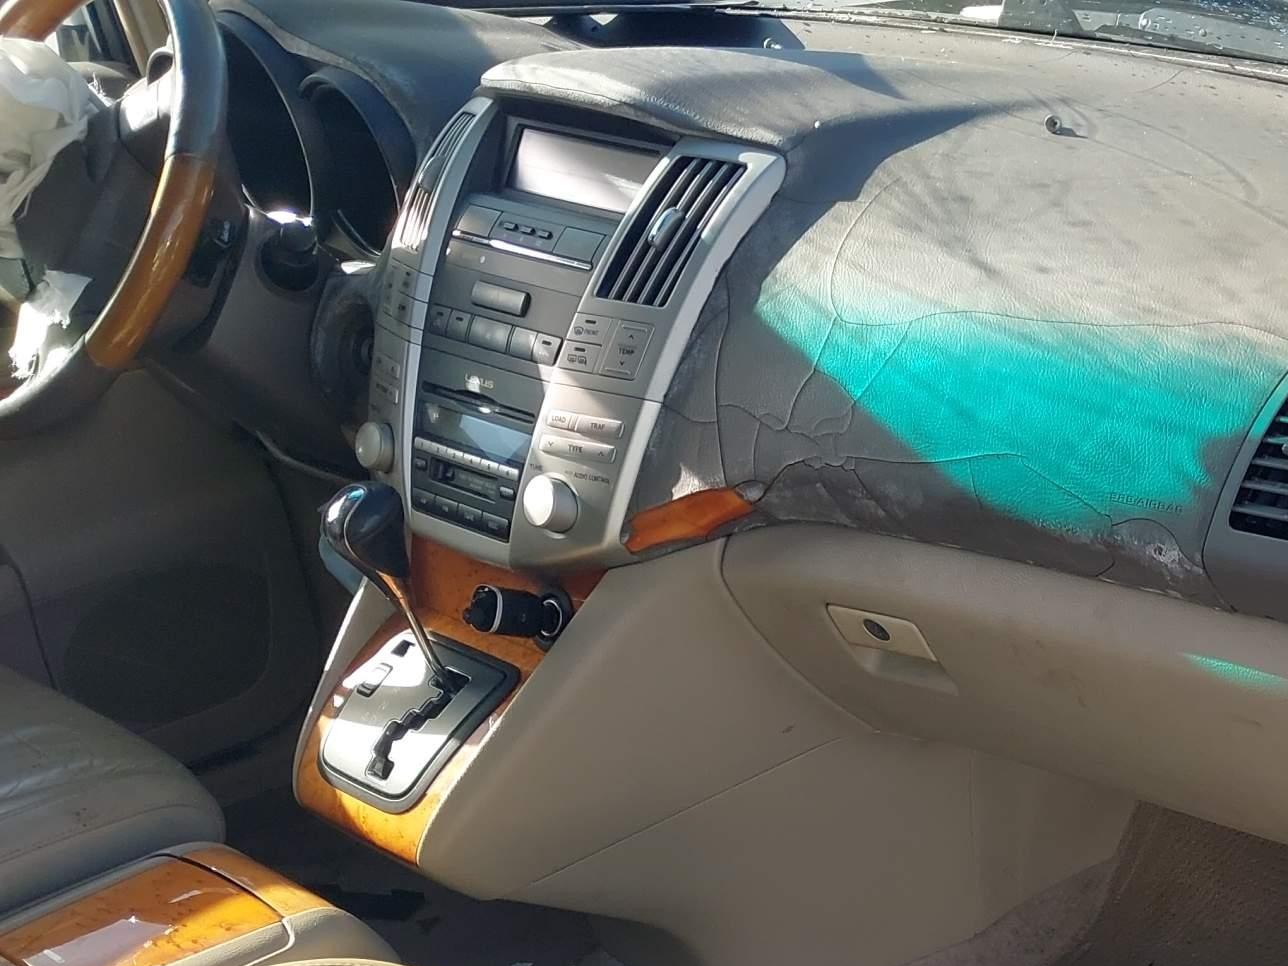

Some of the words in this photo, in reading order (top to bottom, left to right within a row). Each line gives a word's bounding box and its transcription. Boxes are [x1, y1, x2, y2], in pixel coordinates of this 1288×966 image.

[618, 346, 635, 356] TEMP
[551, 415, 567, 424] LOAD
[568, 443, 584, 454] TYPE
